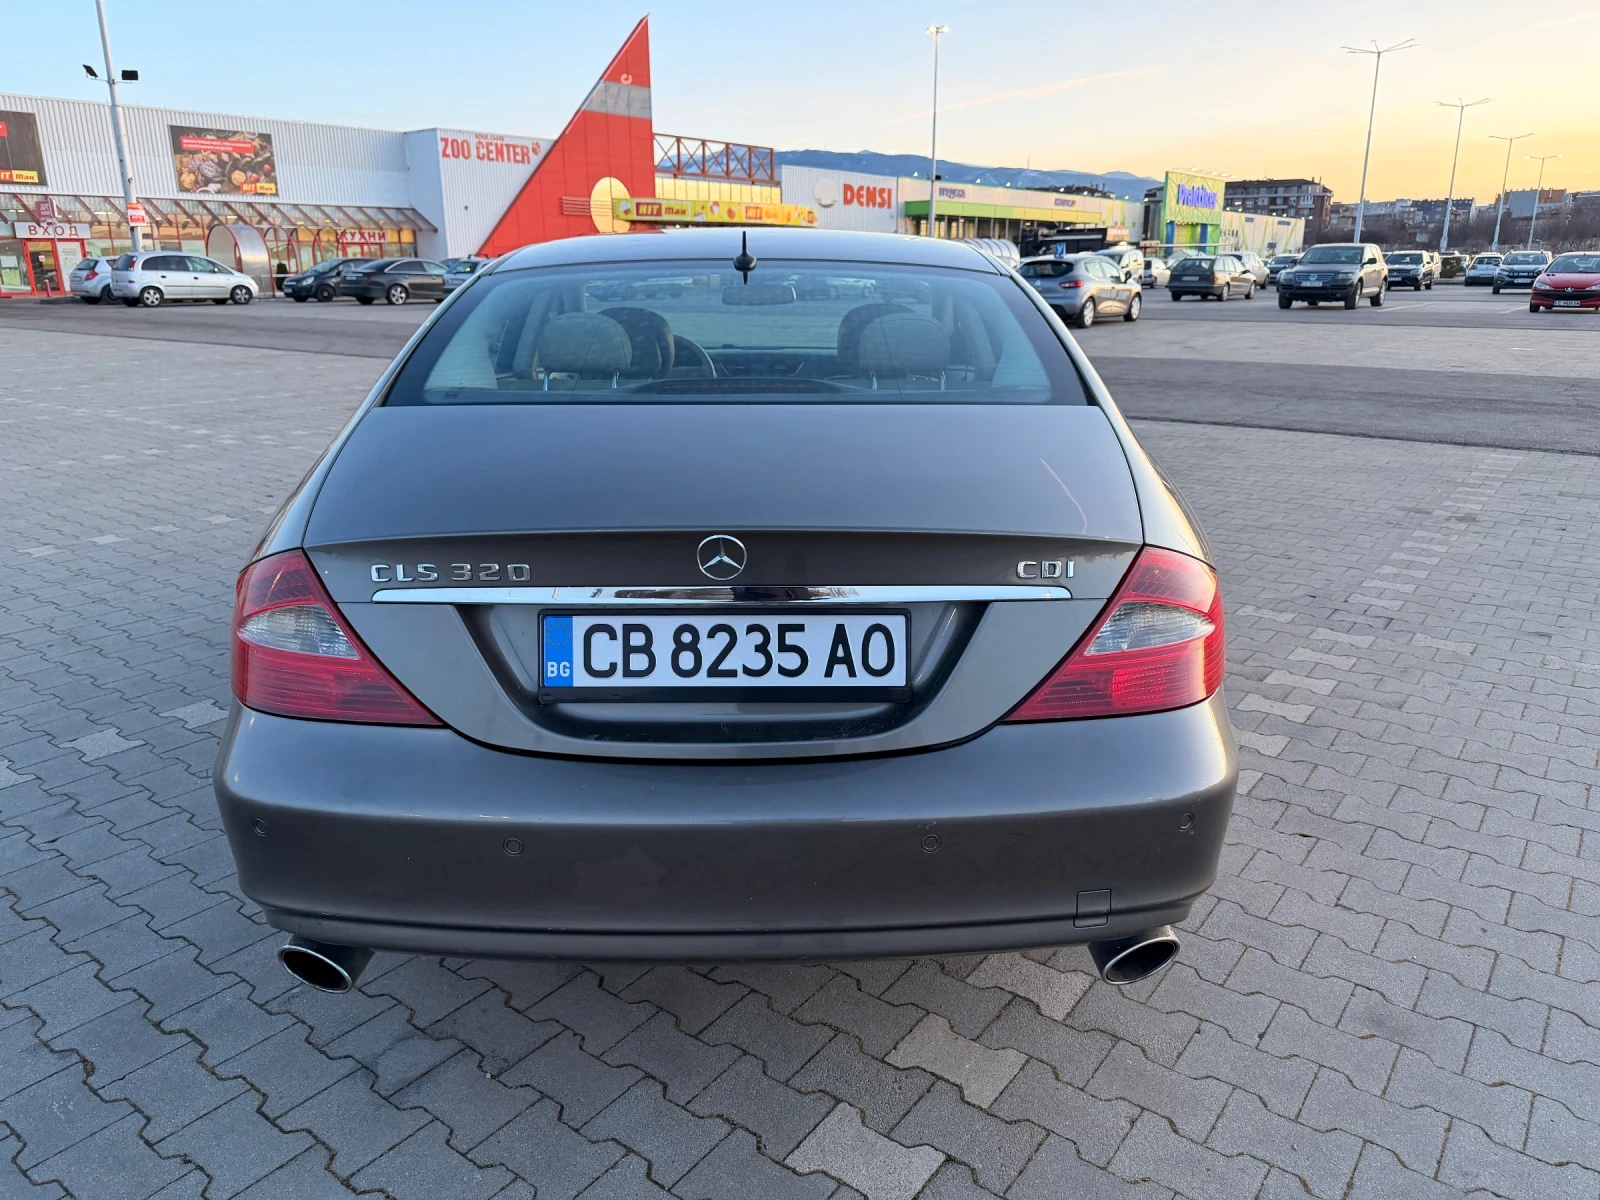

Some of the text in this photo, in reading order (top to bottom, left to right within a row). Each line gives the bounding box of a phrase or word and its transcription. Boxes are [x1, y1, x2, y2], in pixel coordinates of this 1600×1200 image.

[440, 137, 531, 165] ZOO CENTER
[0, 171, 11, 180] IT
[843, 183, 892, 209] DENSI
[1177, 183, 1217, 209] Praktiker
[639, 203, 660, 216] HIT
[28, 225, 79, 238] ВХОД
[340, 230, 387, 242] КУХНИ
[370, 563, 532, 582] CLS 320
[1016, 560, 1075, 579] CDI
[583, 622, 896, 679] CB 8235 AO
[547, 661, 570, 678] BG
